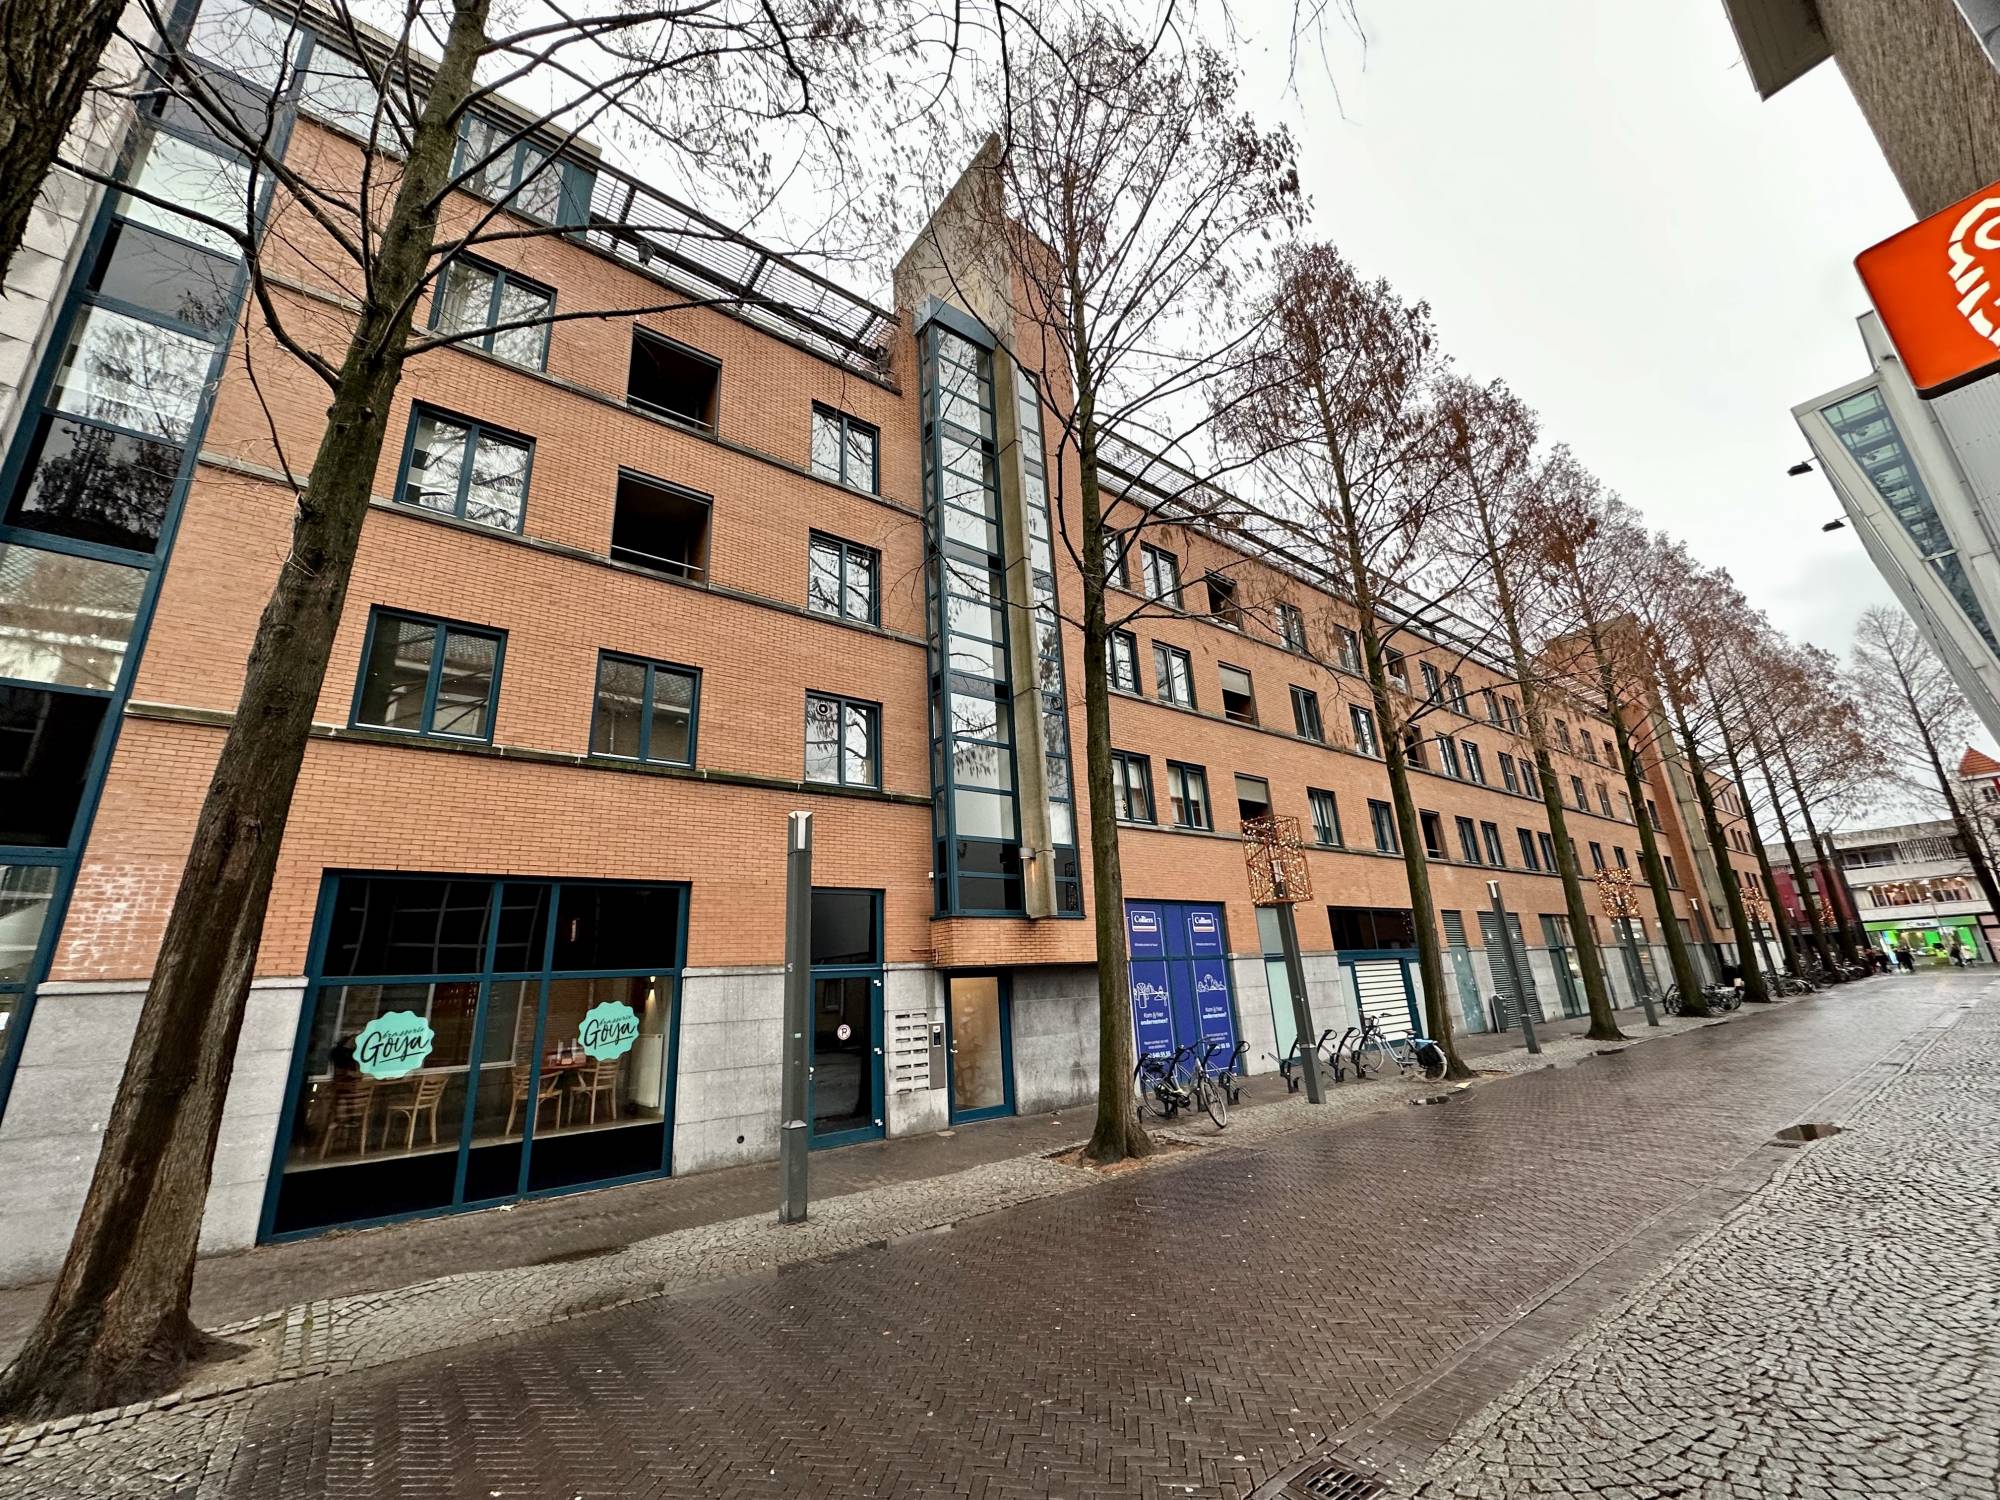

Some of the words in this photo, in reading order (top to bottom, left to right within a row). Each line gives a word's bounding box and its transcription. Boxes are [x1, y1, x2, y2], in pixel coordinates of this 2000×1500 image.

[360, 1031, 429, 1067] Goya
[381, 1026, 425, 1039] brasserie
[584, 1018, 635, 1051] Goya
